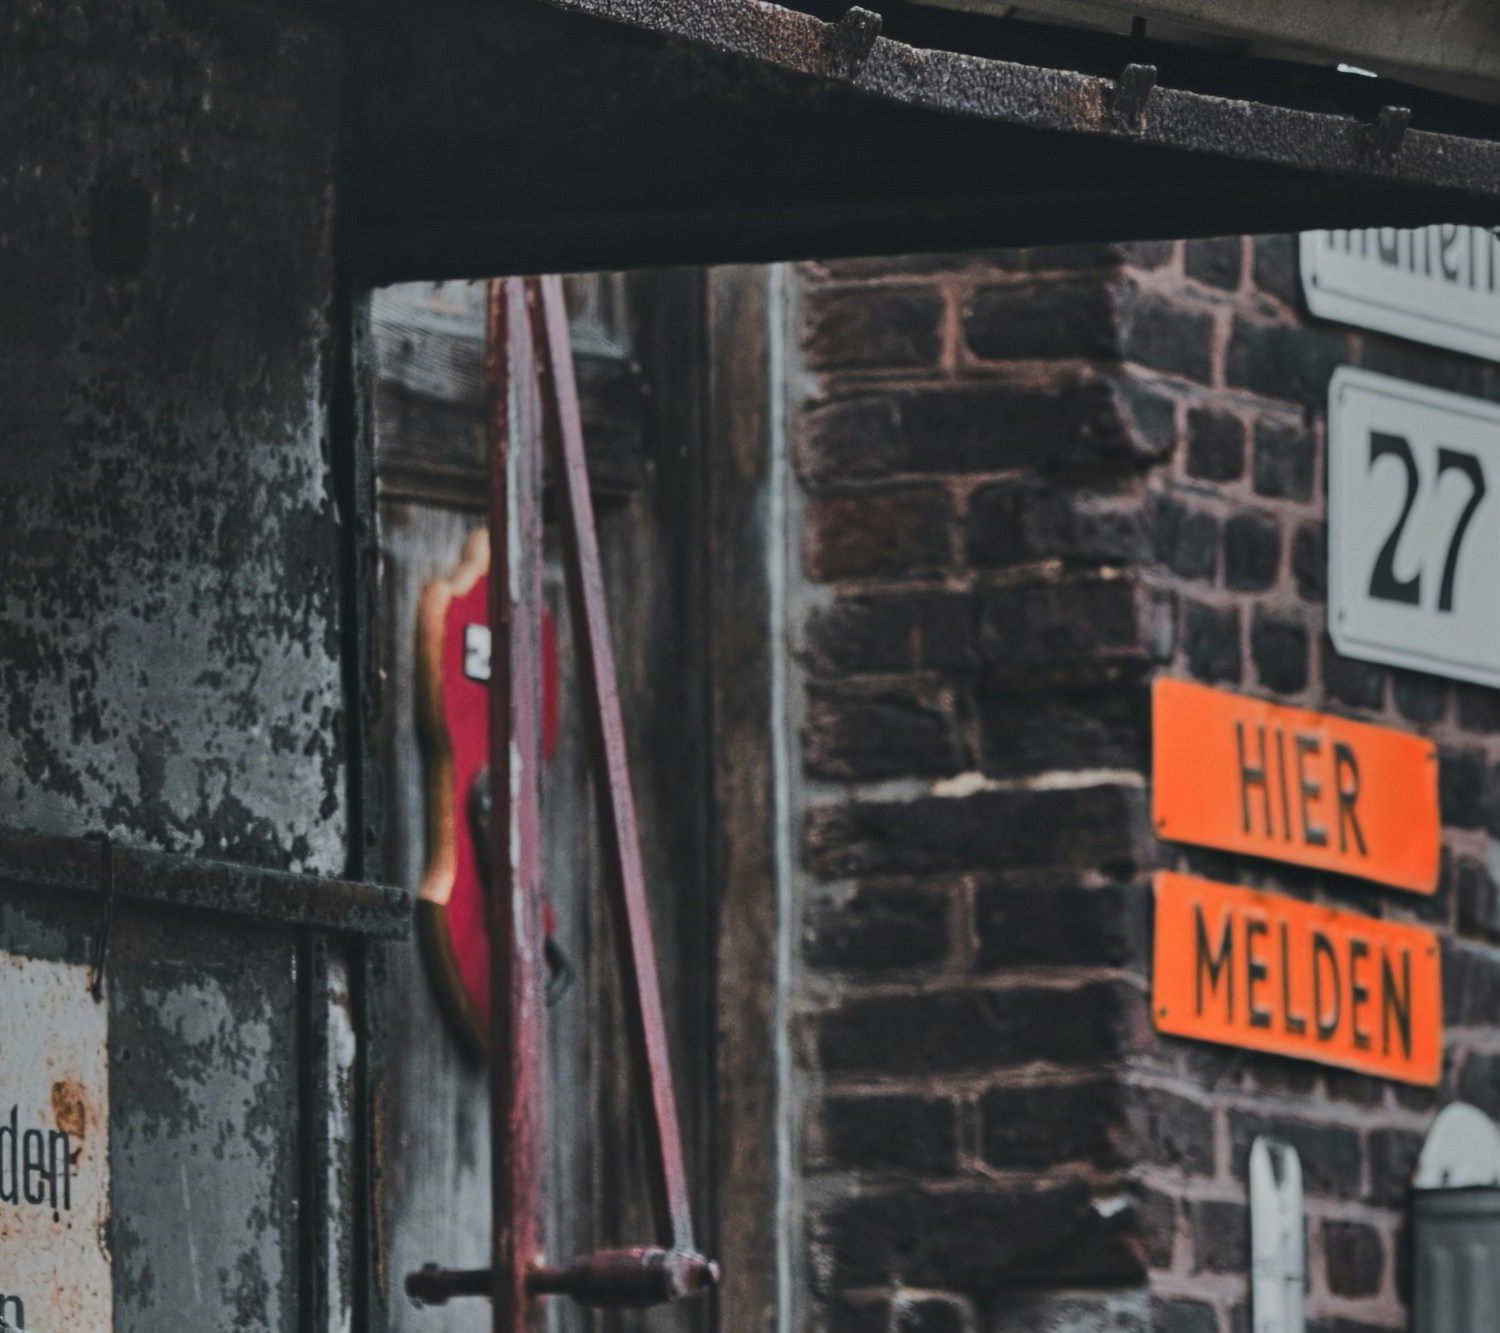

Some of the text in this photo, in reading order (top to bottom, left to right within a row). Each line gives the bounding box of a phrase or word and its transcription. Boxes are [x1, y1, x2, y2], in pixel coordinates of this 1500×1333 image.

[1366, 431, 1488, 613] 27
[1235, 719, 1368, 857] HIER
[1193, 906, 1412, 1062] MELDEN
